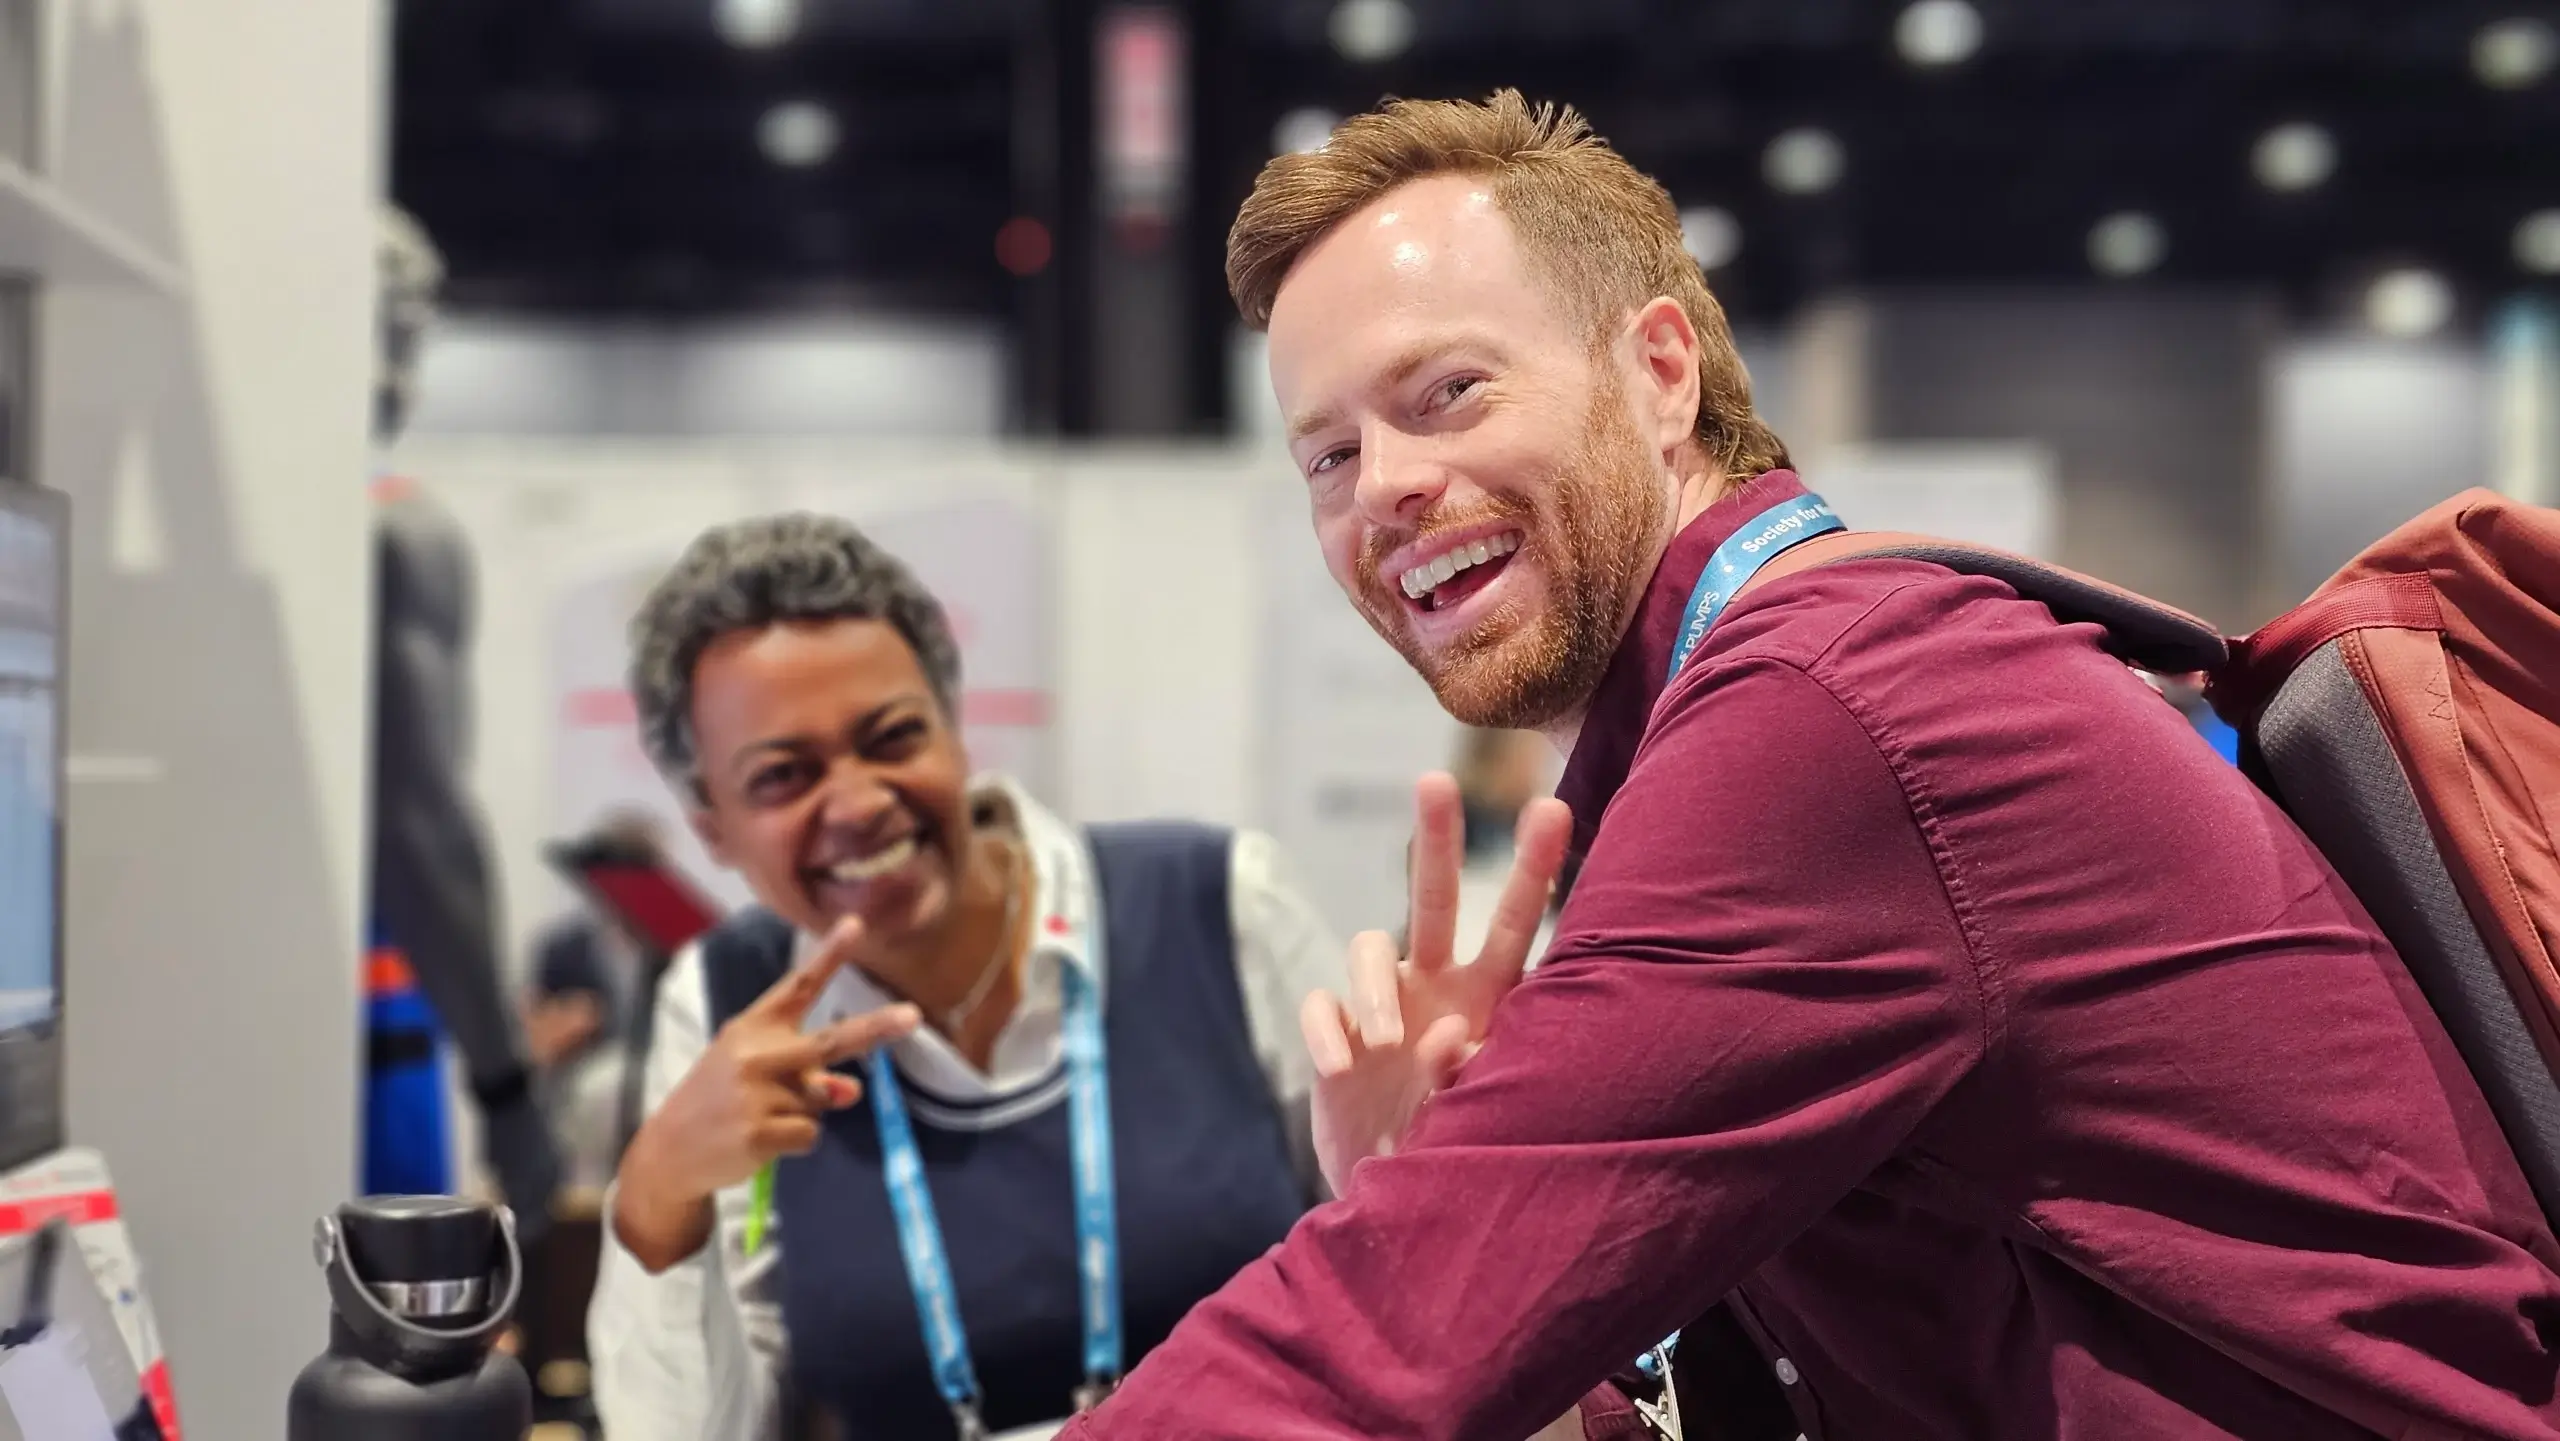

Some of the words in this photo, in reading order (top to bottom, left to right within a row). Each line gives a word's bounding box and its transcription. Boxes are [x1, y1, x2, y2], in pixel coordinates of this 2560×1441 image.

[1741, 515, 1802, 552] Society
[1797, 508, 1820, 521] for
[1685, 591, 1720, 649] PUMPS
